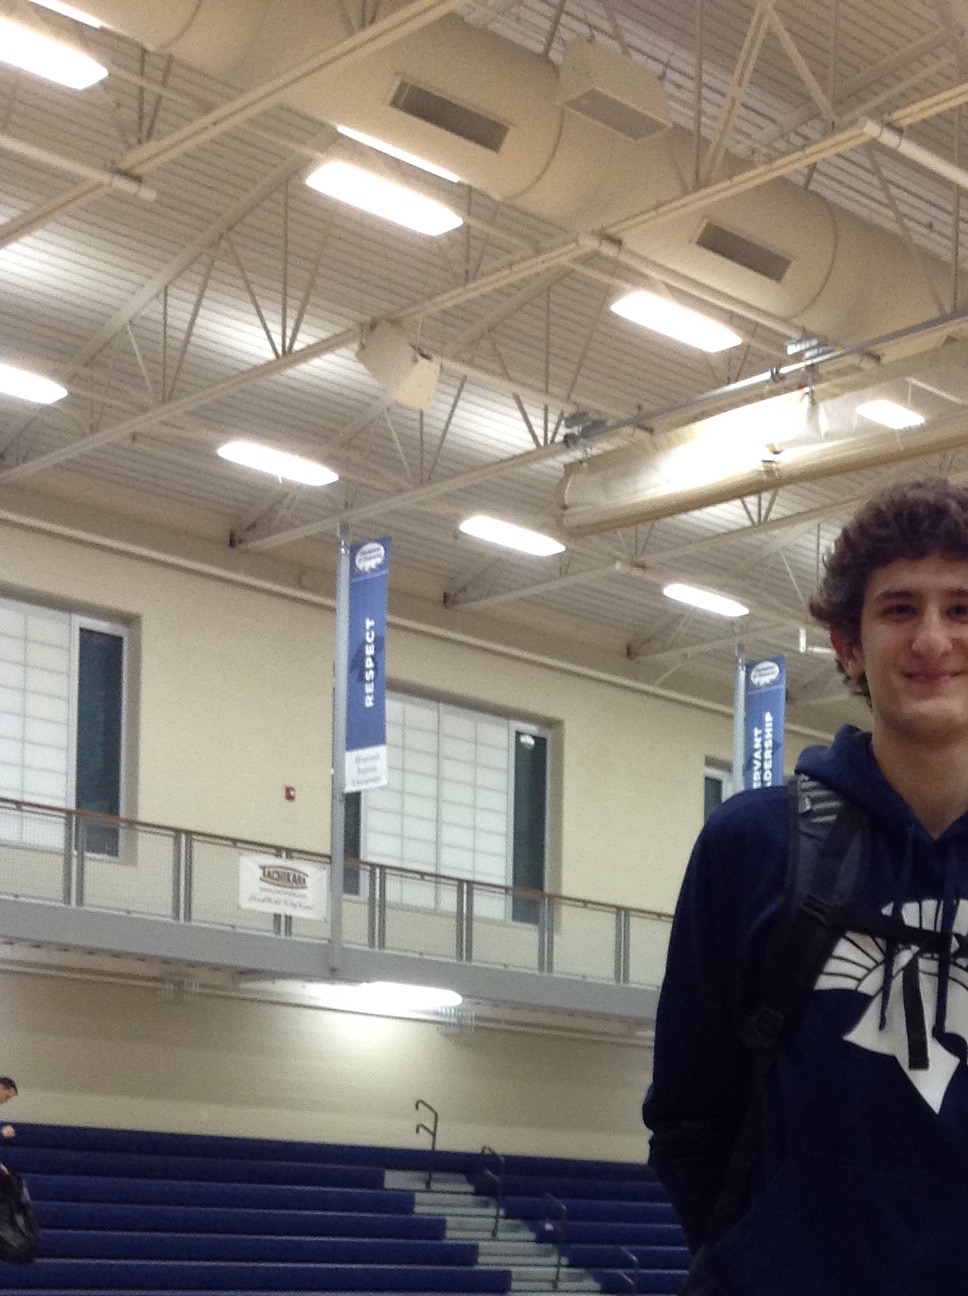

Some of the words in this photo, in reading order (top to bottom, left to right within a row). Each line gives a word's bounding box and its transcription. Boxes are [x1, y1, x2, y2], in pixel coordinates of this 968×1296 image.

[364, 617, 376, 709] RESPECT
[752, 726, 763, 790] ERVANT
[762, 711, 774, 788] DERSHIP
